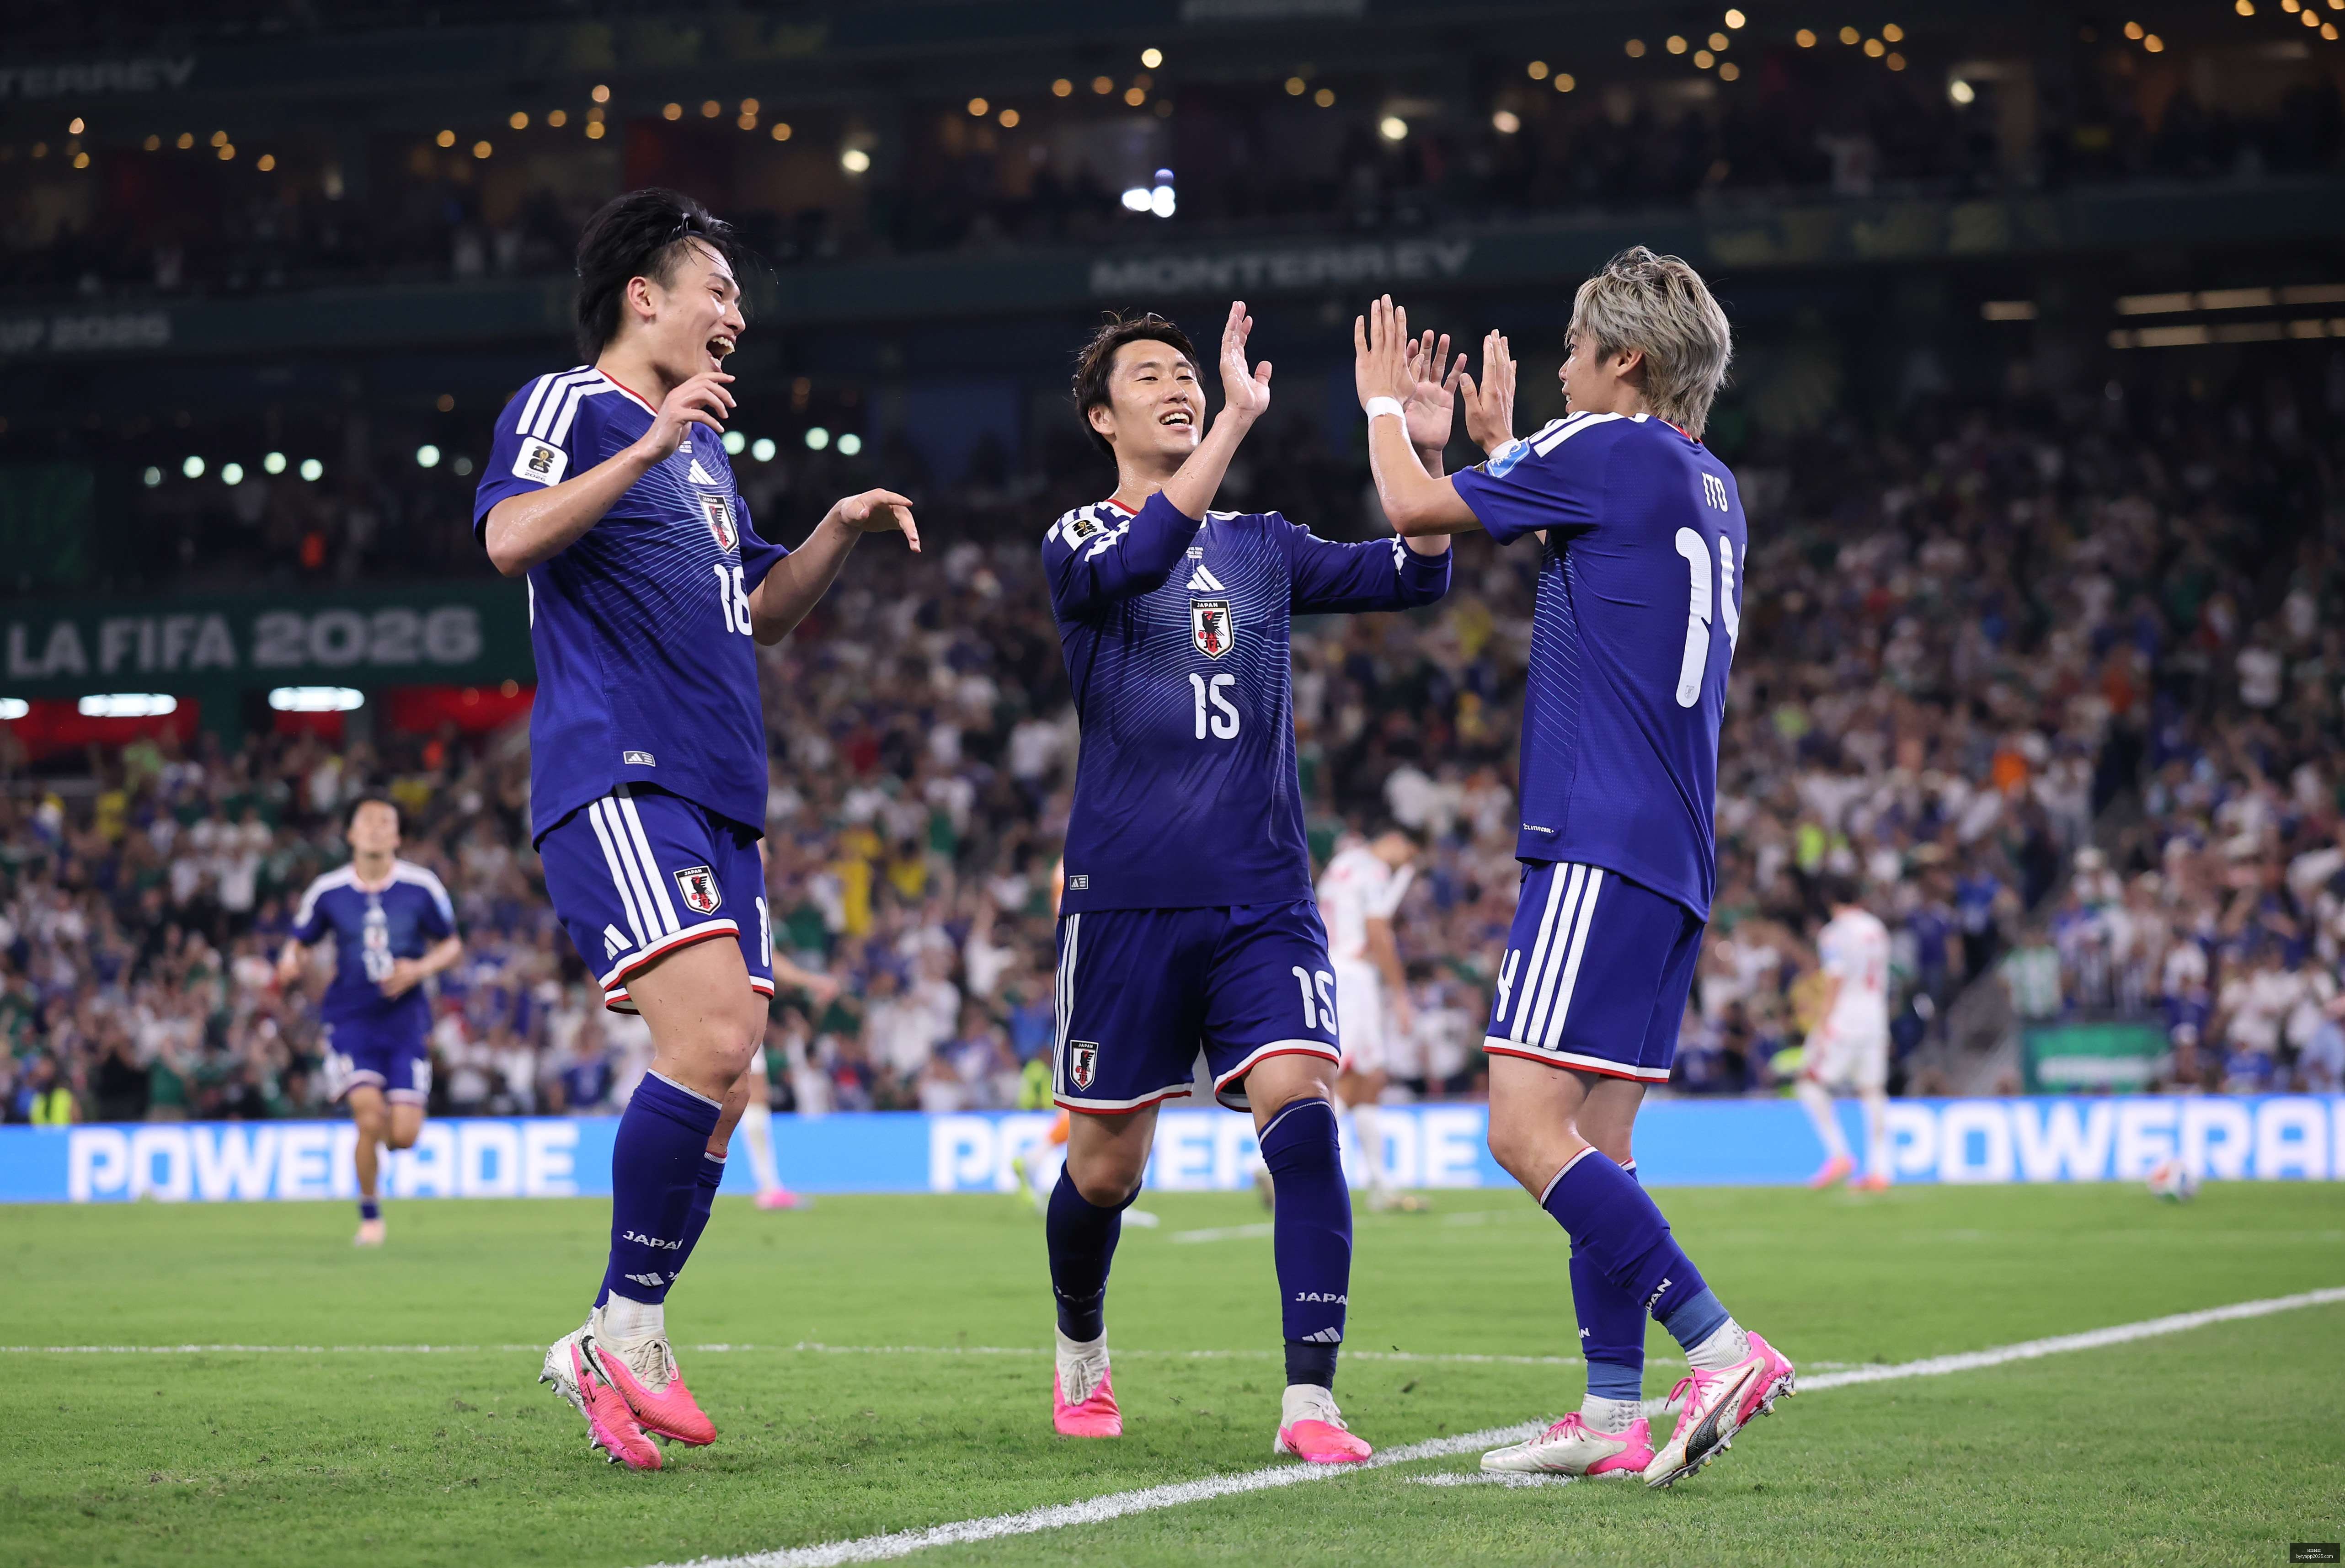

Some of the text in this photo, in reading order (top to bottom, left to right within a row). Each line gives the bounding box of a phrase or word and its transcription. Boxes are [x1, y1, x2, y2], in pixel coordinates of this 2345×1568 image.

[1090, 240, 1473, 295] MONTERREY
[524, 471, 545, 482] 2026
[1702, 472, 1728, 512] ITO
[714, 564, 753, 635] 18
[6, 605, 482, 678] LA FIFA 2026
[1204, 640, 1222, 649] JFA
[1189, 673, 1239, 739] 15
[698, 898, 714, 907] JFA
[756, 896, 773, 967] 1
[1292, 966, 1337, 1035] 15
[1881, 1098, 2345, 1183] POWERA
[1295, 1292, 1348, 1305] JAPA
[1645, 1278, 1672, 1312] PAN
